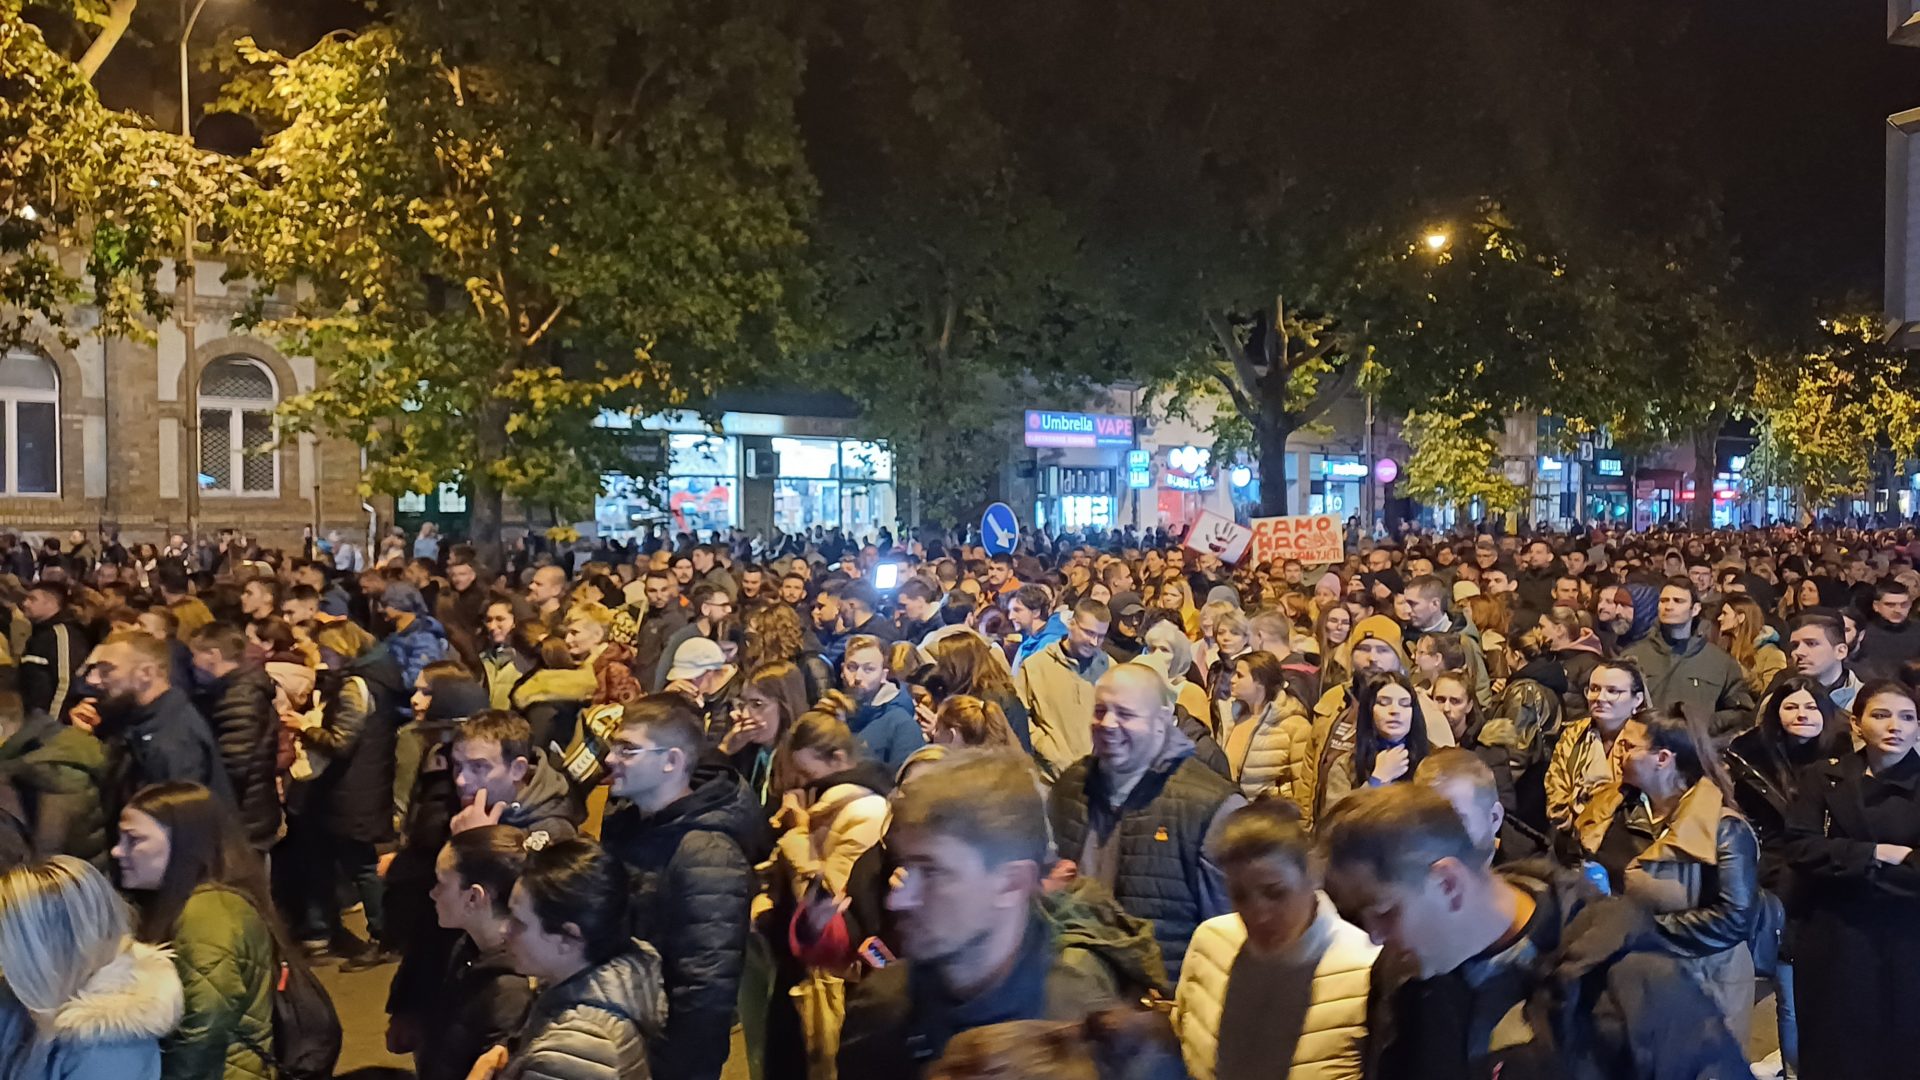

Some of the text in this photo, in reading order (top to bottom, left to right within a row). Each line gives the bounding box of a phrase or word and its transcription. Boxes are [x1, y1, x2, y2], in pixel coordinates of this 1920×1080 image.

[1041, 414, 1132, 436] Umbrella VAPE
[1257, 517, 1330, 536] САМО
[1258, 534, 1307, 550] НАС
